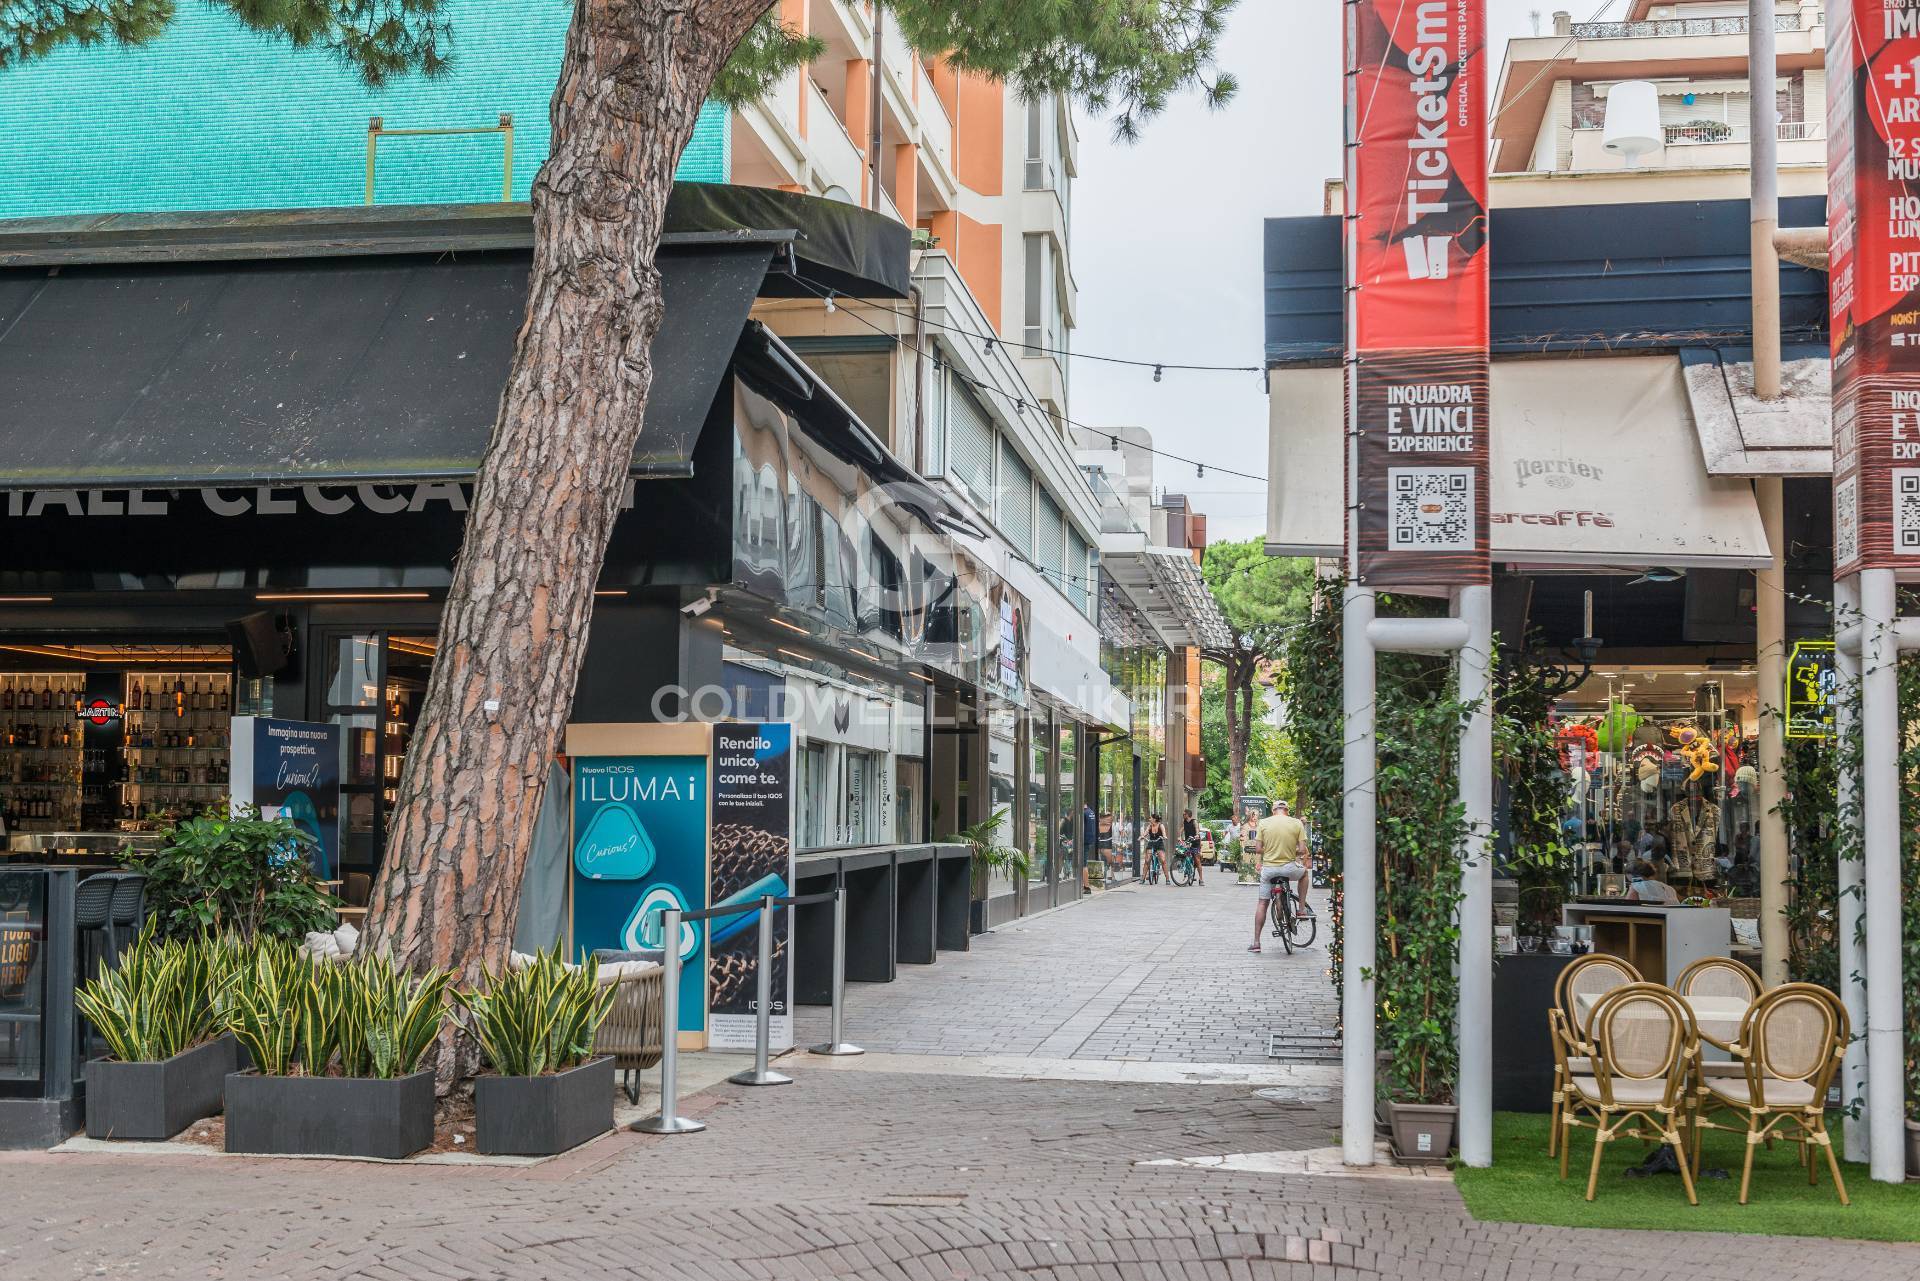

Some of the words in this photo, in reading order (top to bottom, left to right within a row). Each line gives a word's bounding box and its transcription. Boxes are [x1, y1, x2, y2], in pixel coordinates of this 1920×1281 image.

[1457, 0, 1467, 22] PAR
[1884, 8, 1920, 40] IM
[1458, 24, 1467, 79] TICKETING
[1458, 80, 1468, 127] OFFICIAL
[1887, 158, 1920, 180] MU
[1388, 385, 1473, 404] INQUADRA
[1388, 408, 1402, 433] E
[1409, 406, 1473, 433] VINCI
[1388, 435, 1473, 452] EXPERIENCE
[719, 736, 772, 750] Rendilo
[582, 766, 605, 774] Nuovo
[606, 765, 635, 774] IQOS
[719, 753, 760, 770] unico,
[582, 776, 681, 801] ILUMA
[689, 776, 695, 801] i
[718, 774, 757, 785] come
[759, 772, 780, 785] te.
[586, 834, 637, 863] Curious?
